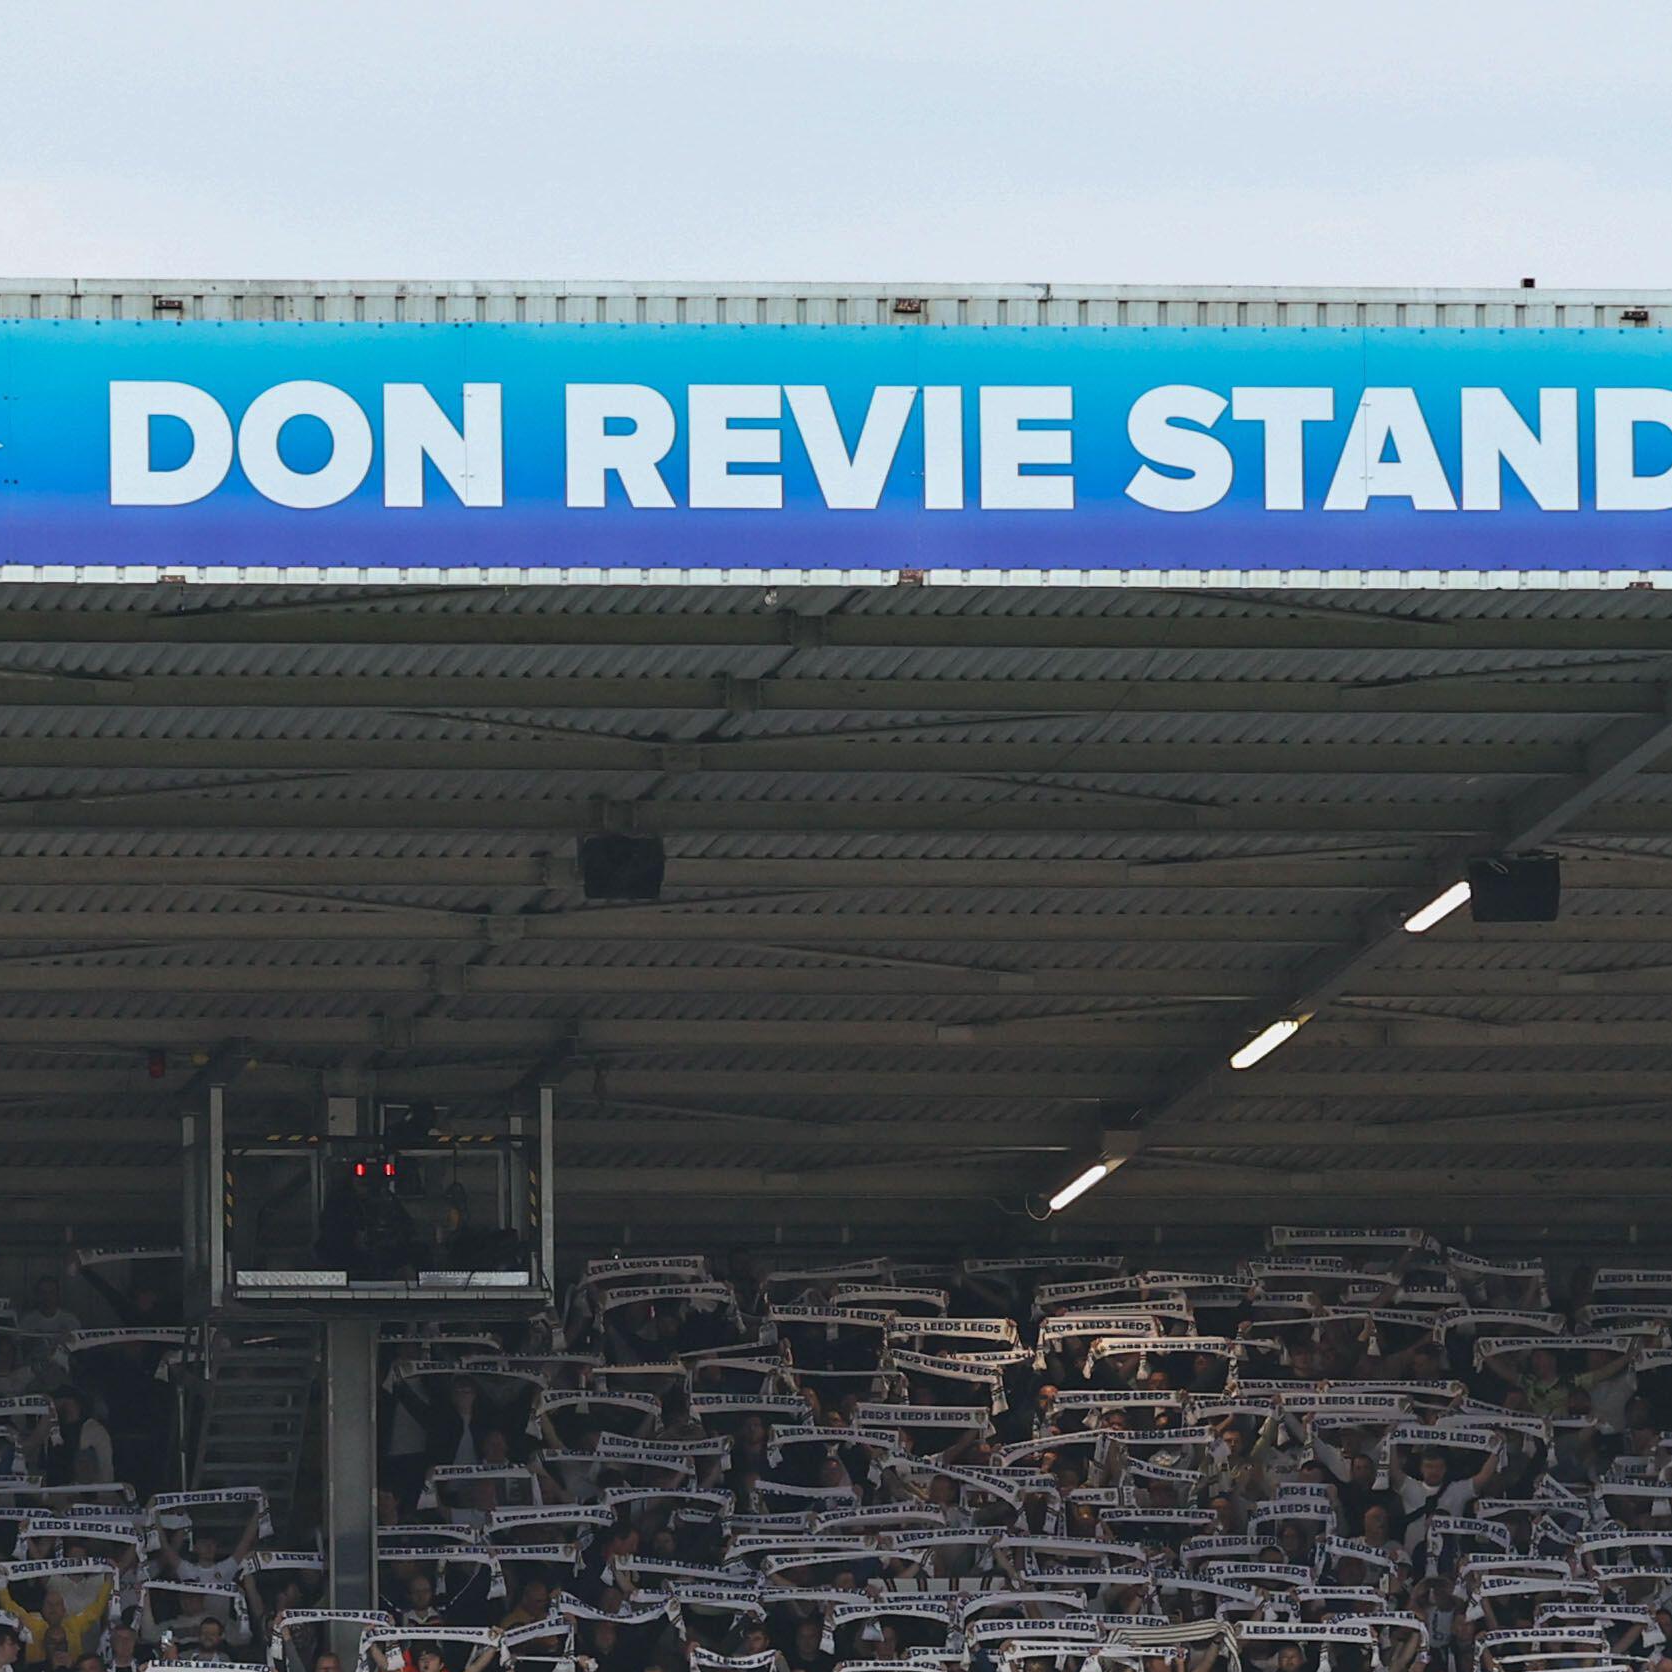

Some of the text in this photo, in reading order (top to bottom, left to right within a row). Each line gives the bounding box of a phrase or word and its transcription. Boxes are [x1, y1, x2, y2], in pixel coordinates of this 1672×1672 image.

[108, 379, 503, 509] DON
[565, 382, 1075, 511] REVIE
[773, 1306, 886, 1322] LEEDS LEEDS LEEDS
[924, 1322, 1000, 1333] LEEDS LEEDS
[1077, 1320, 1151, 1332] LEEDS LEEDS
[1320, 1396, 1395, 1408] LEEDS LEEDS
[894, 1411, 971, 1422] LEEDS LEEDS
